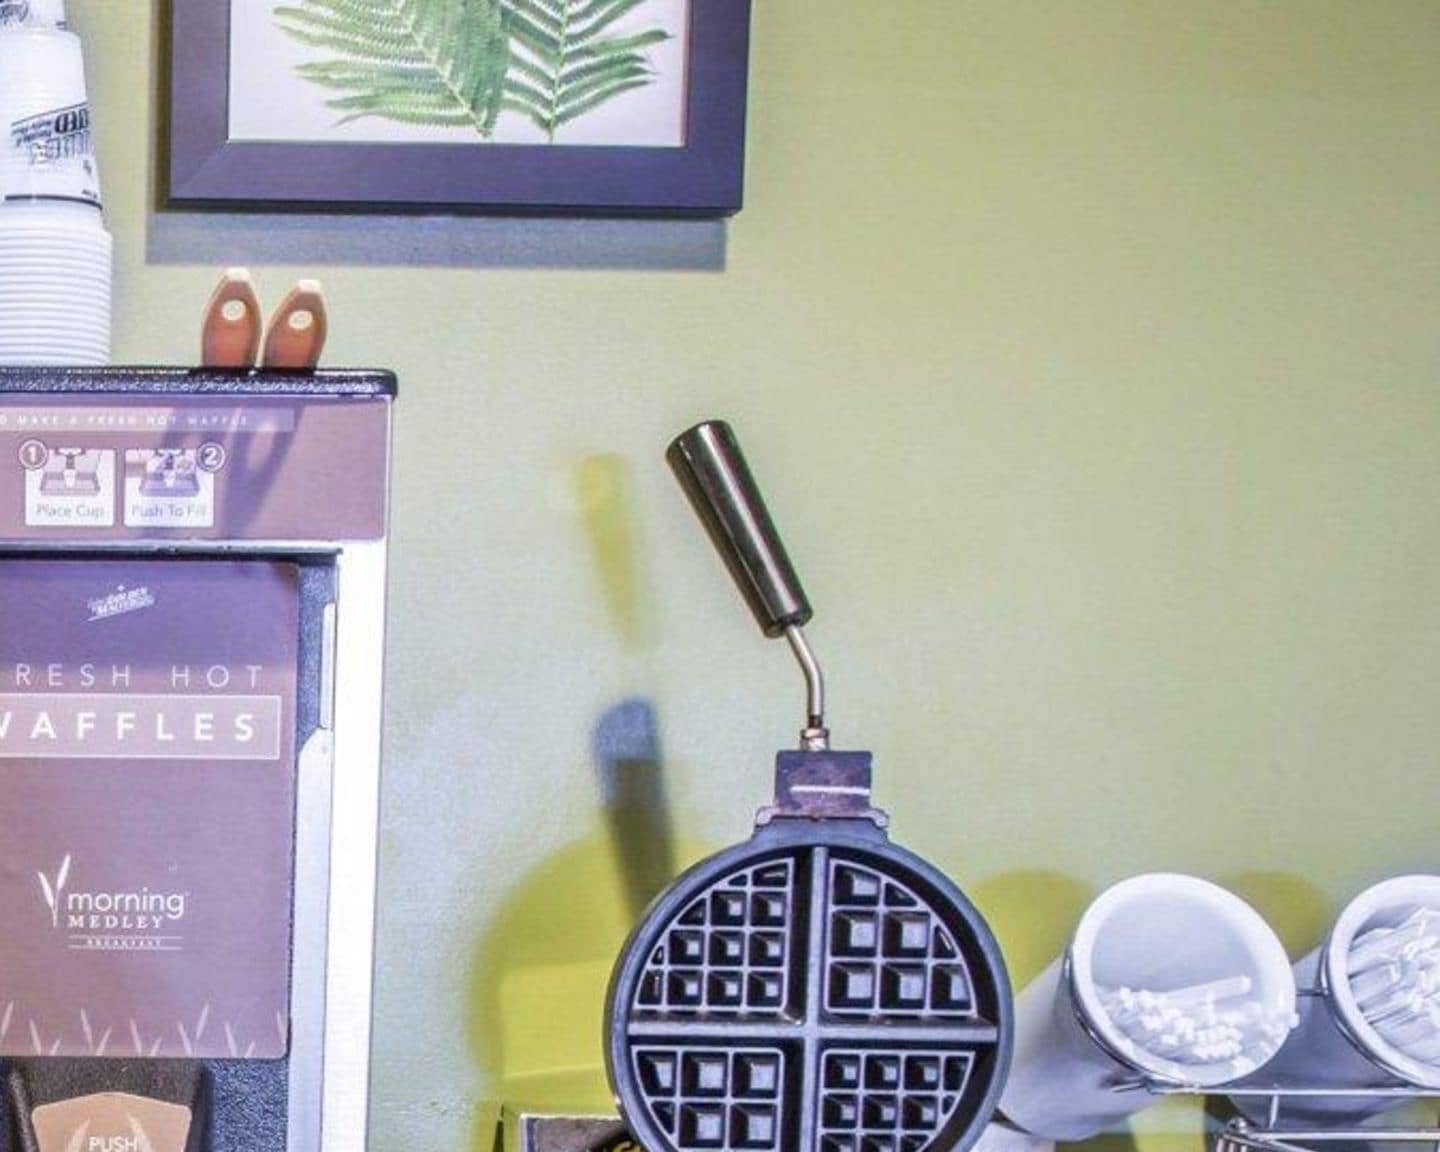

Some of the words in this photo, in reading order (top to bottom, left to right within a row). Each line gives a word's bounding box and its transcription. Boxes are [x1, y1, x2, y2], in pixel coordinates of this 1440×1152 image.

[17, 415, 59, 426] MAKE
[87, 415, 138, 426] FRESH
[36, 503, 73, 518] Place
[76, 503, 105, 520] Cup
[131, 504, 164, 518] Push
[169, 504, 184, 517] To
[187, 504, 207, 517] Fill
[171, 664, 262, 688] HOT
[66, 886, 185, 920] morning
[67, 914, 163, 929] MEDLEY
[88, 1136, 138, 1152] PUSH
